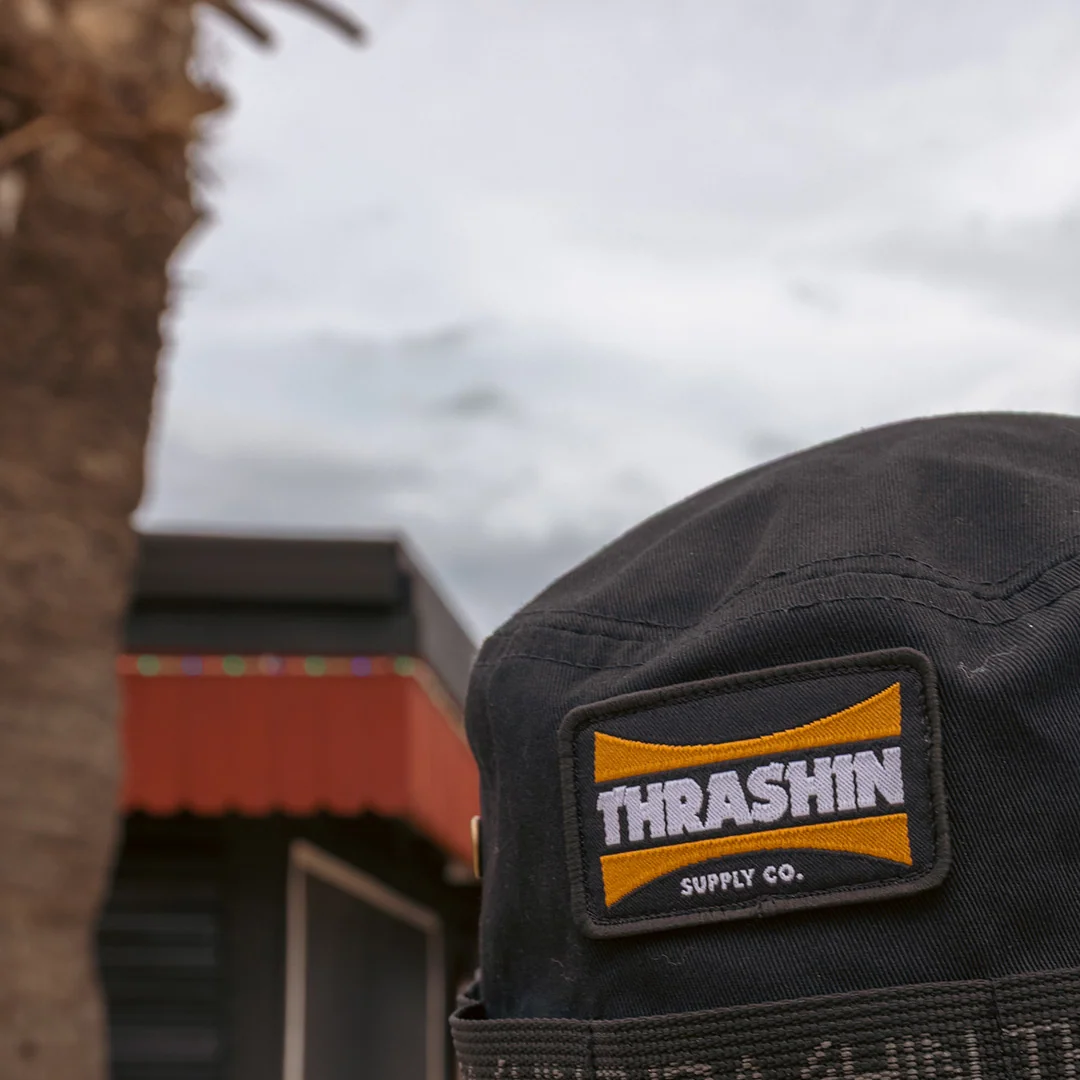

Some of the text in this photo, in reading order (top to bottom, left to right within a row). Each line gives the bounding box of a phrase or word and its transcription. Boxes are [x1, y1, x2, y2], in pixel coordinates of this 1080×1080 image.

[597, 746, 904, 847] THRASHIN
[680, 863, 804, 897] SUPPLY CO.
